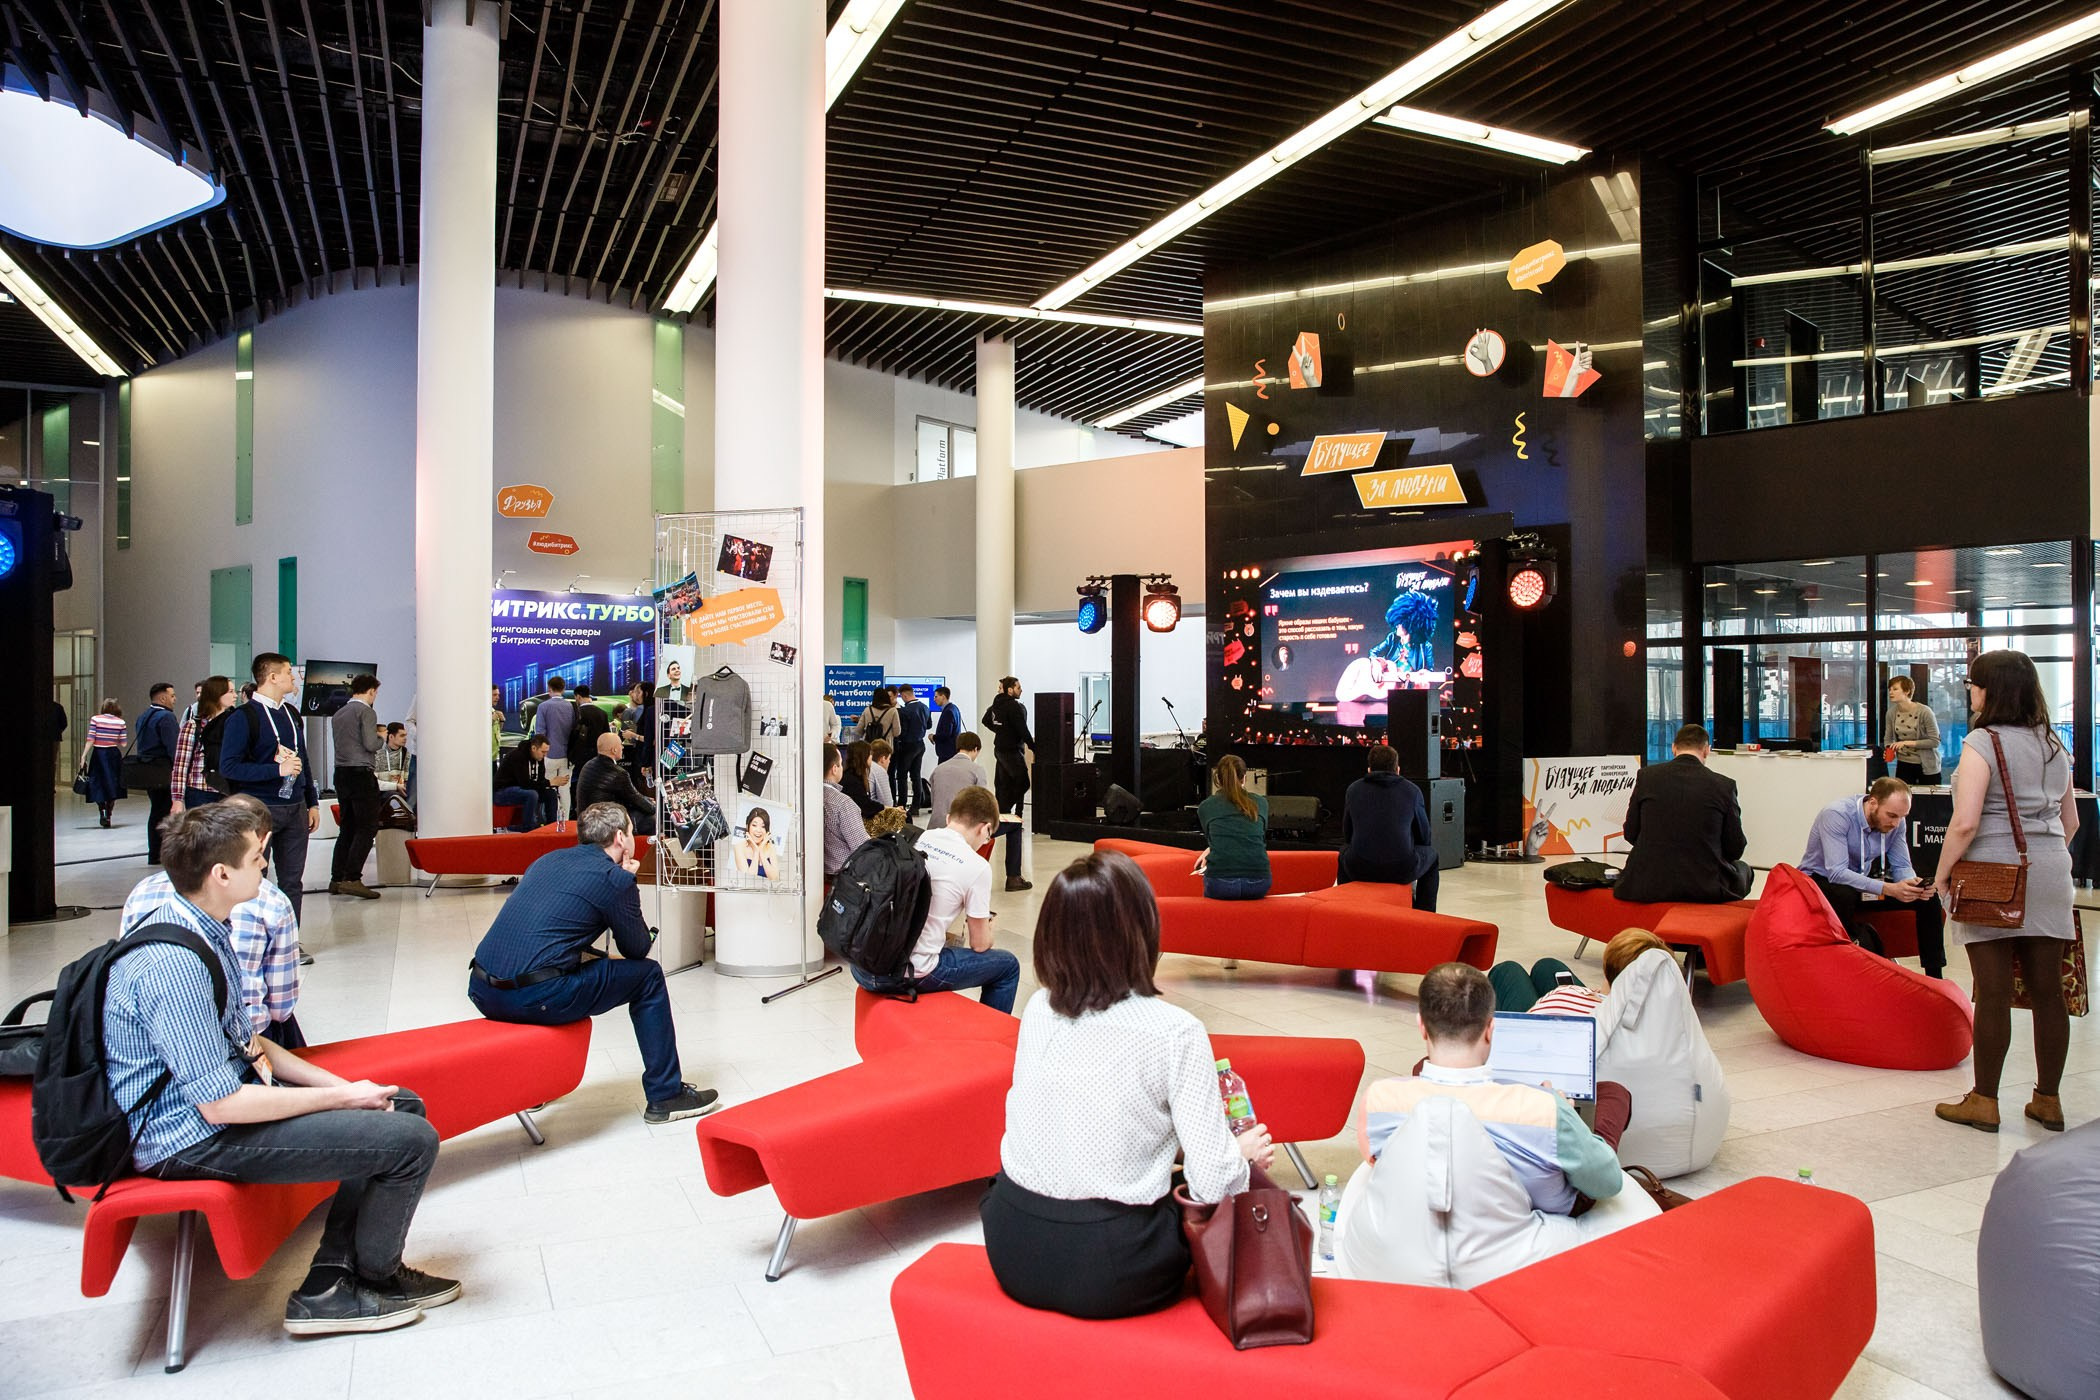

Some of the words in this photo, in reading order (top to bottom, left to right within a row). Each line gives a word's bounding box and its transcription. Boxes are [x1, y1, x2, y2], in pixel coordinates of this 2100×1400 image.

[1269, 588, 1296, 599] Зачем
[1297, 588, 1310, 597] вы
[1310, 582, 1370, 597] издеваетесь?
[491, 599, 655, 623] ИТРИКС.ТУРБО
[491, 625, 559, 635] нингованные
[560, 628, 601, 637] серверы
[500, 634, 590, 646] Битрикс-проектов
[828, 678, 881, 688] Конструктор
[828, 689, 874, 697] AI-чатбото
[1924, 825, 1948, 833] издат
[1924, 834, 1945, 844] МАН
